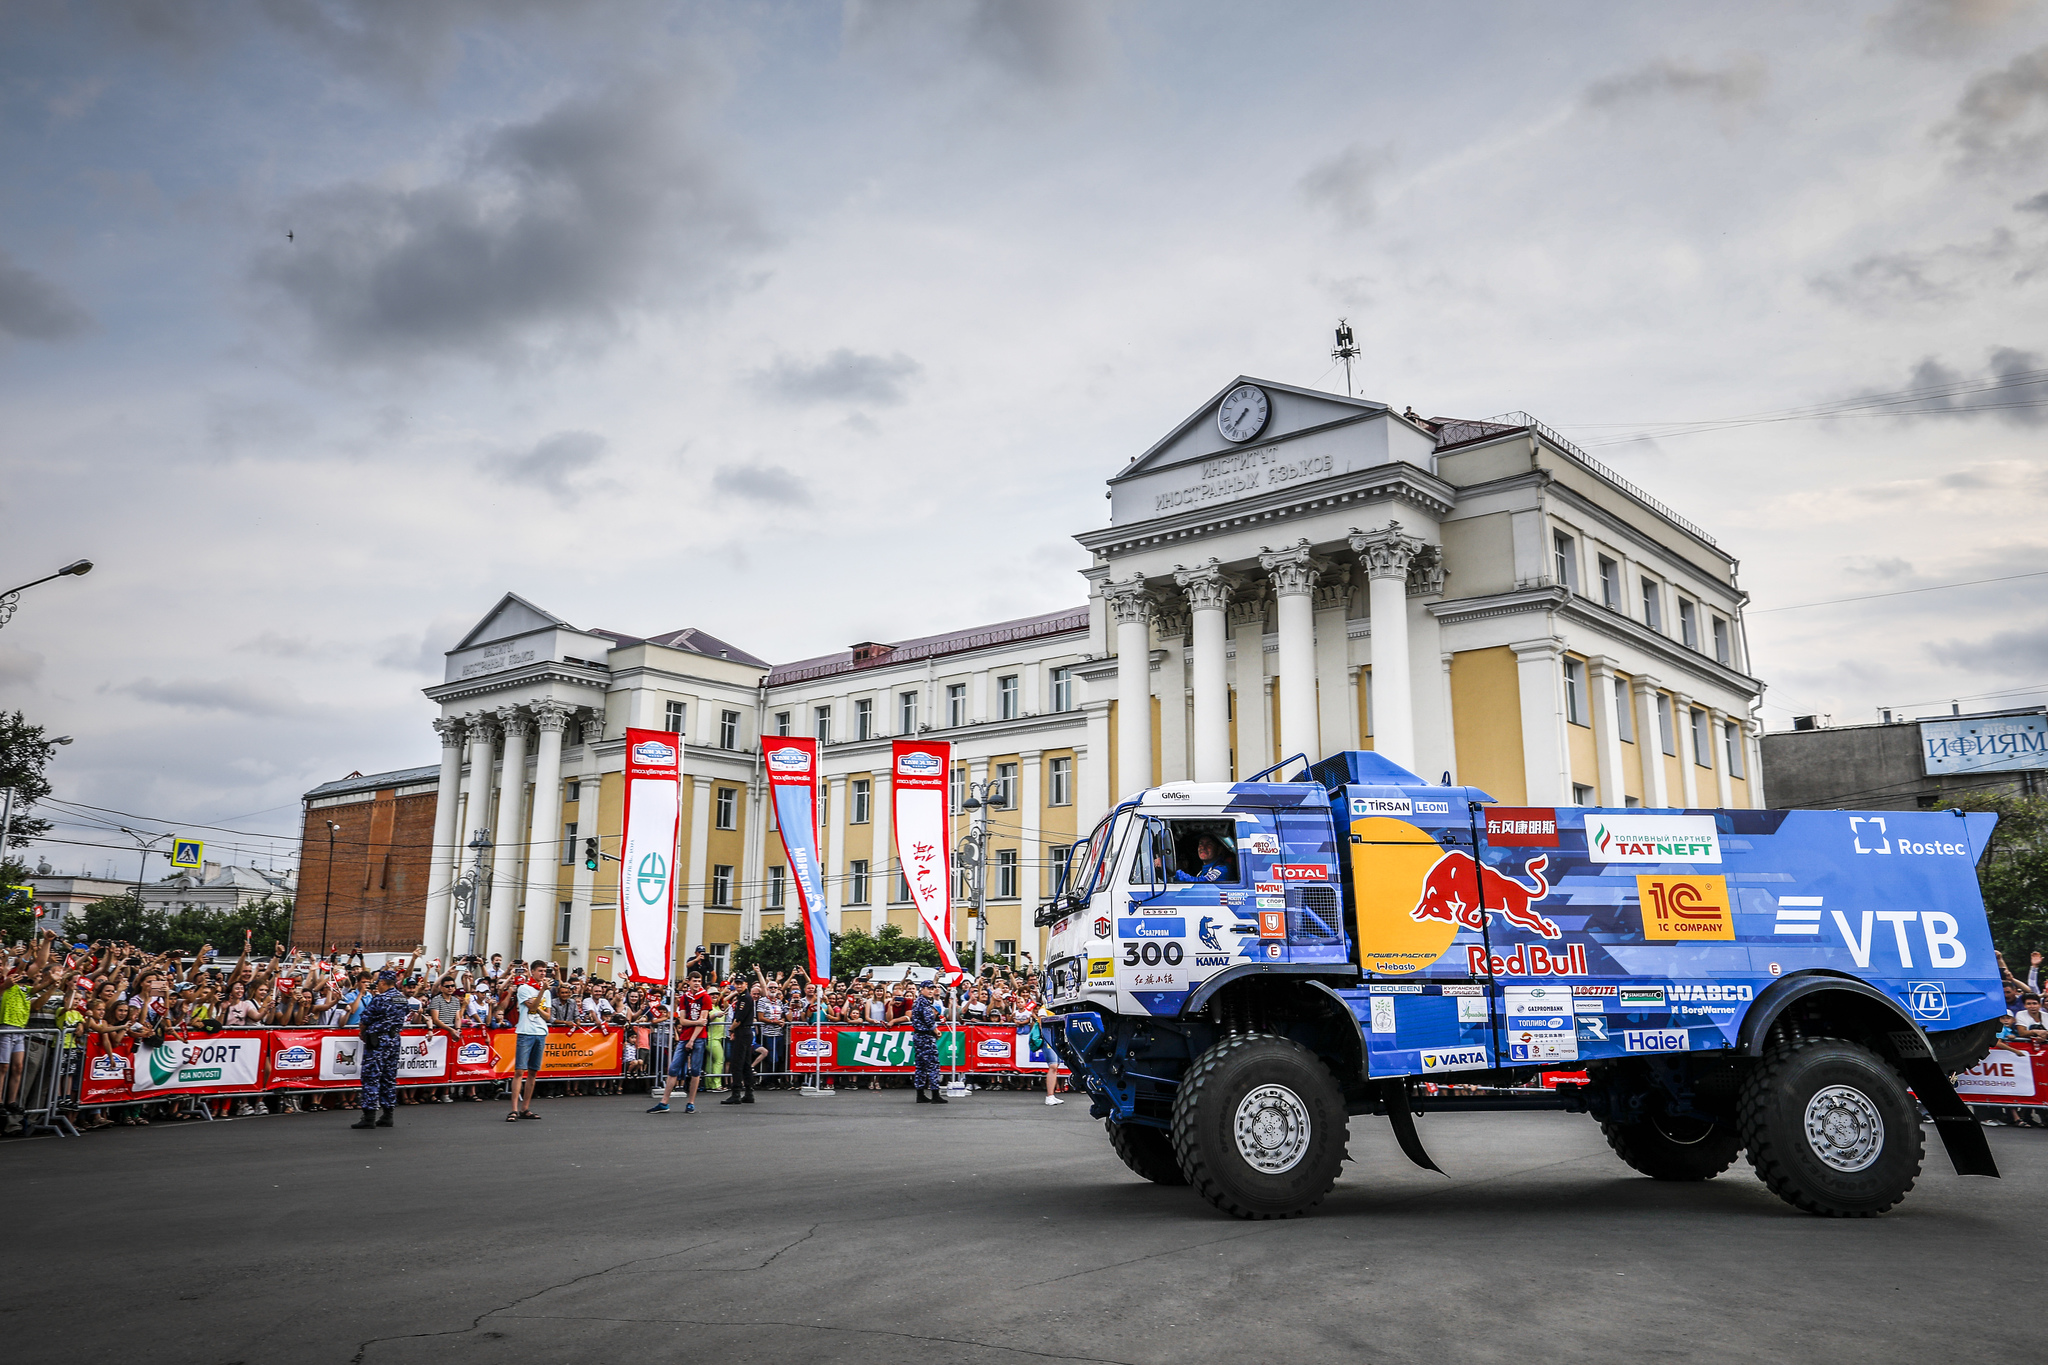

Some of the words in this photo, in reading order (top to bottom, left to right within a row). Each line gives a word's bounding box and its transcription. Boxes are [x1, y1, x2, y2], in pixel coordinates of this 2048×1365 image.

[1201, 446, 1278, 479] ИНСТИТУТ
[1155, 471, 1259, 511] ИНОСТРАННЫХ
[1267, 454, 1334, 485] ЯЗЫКОВ
[1926, 731, 2047, 758] ИФИЯМ
[1416, 803, 1448, 812] LEONI
[1487, 820, 1556, 835] 东风康明斯
[1616, 843, 1713, 856] TATNEFT
[1899, 838, 1966, 857] Rostec
[1274, 866, 1326, 878] TOTAL
[1658, 923, 1670, 931] 1C
[1674, 923, 1723, 932] COMPANY
[1830, 910, 1967, 969] VTB
[1123, 941, 1184, 967] 300
[1271, 947, 1278, 956] E
[1196, 957, 1230, 966] KAMAZ
[1466, 944, 1527, 976] Red
[1531, 944, 1588, 976] Bull
[1376, 962, 1416, 971] Webasto
[1771, 964, 1779, 975] E
[1371, 985, 1421, 993] ICEQUEEN
[1574, 986, 1616, 995] LOCTITE
[1666, 985, 1754, 1001] WABCO
[1681, 1005, 1736, 1016] BorgWarner
[1078, 1021, 1095, 1033] VTB
[1628, 1031, 1684, 1050] Haier
[1439, 1052, 1486, 1065] VARTA
[181, 1071, 192, 1080] RIA
[193, 1071, 220, 1079] NOVOSTI
